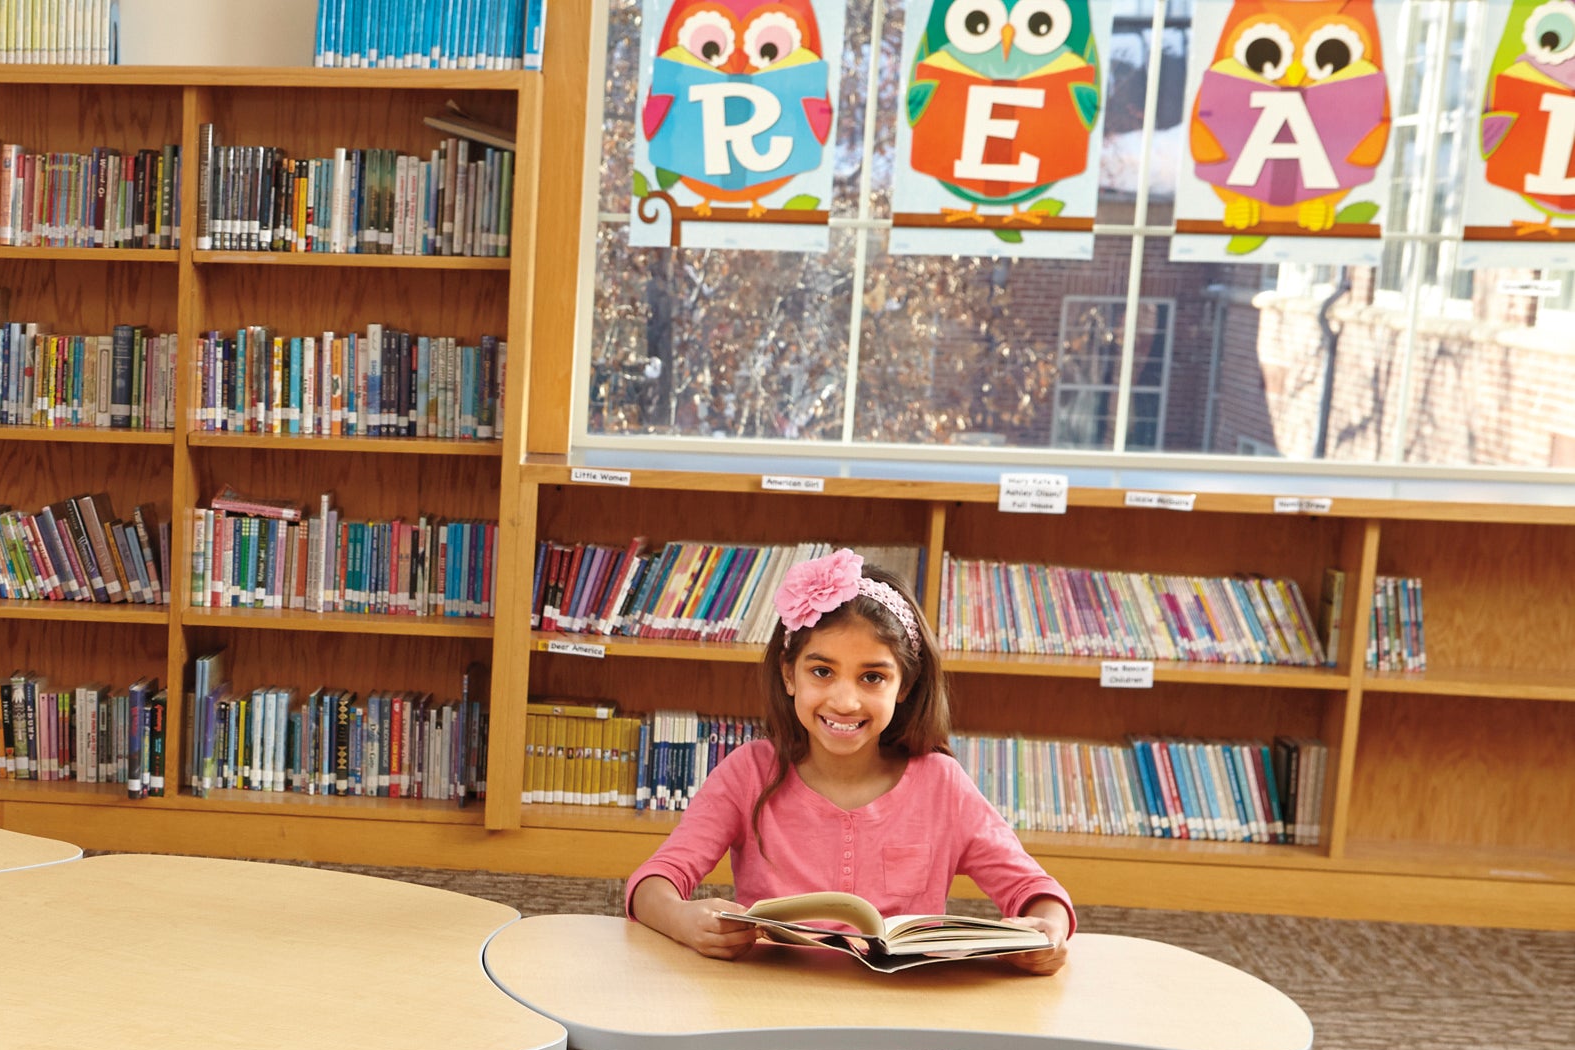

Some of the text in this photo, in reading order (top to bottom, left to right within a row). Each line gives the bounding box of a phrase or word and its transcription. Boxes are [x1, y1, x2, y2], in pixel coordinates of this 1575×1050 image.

[688, 82, 793, 176] R
[954, 86, 1046, 184] E
[1226, 91, 1339, 190] A
[575, 471, 628, 483] Little Women
[551, 642, 603, 656] Dear America
[1109, 676, 1144, 684] Children
